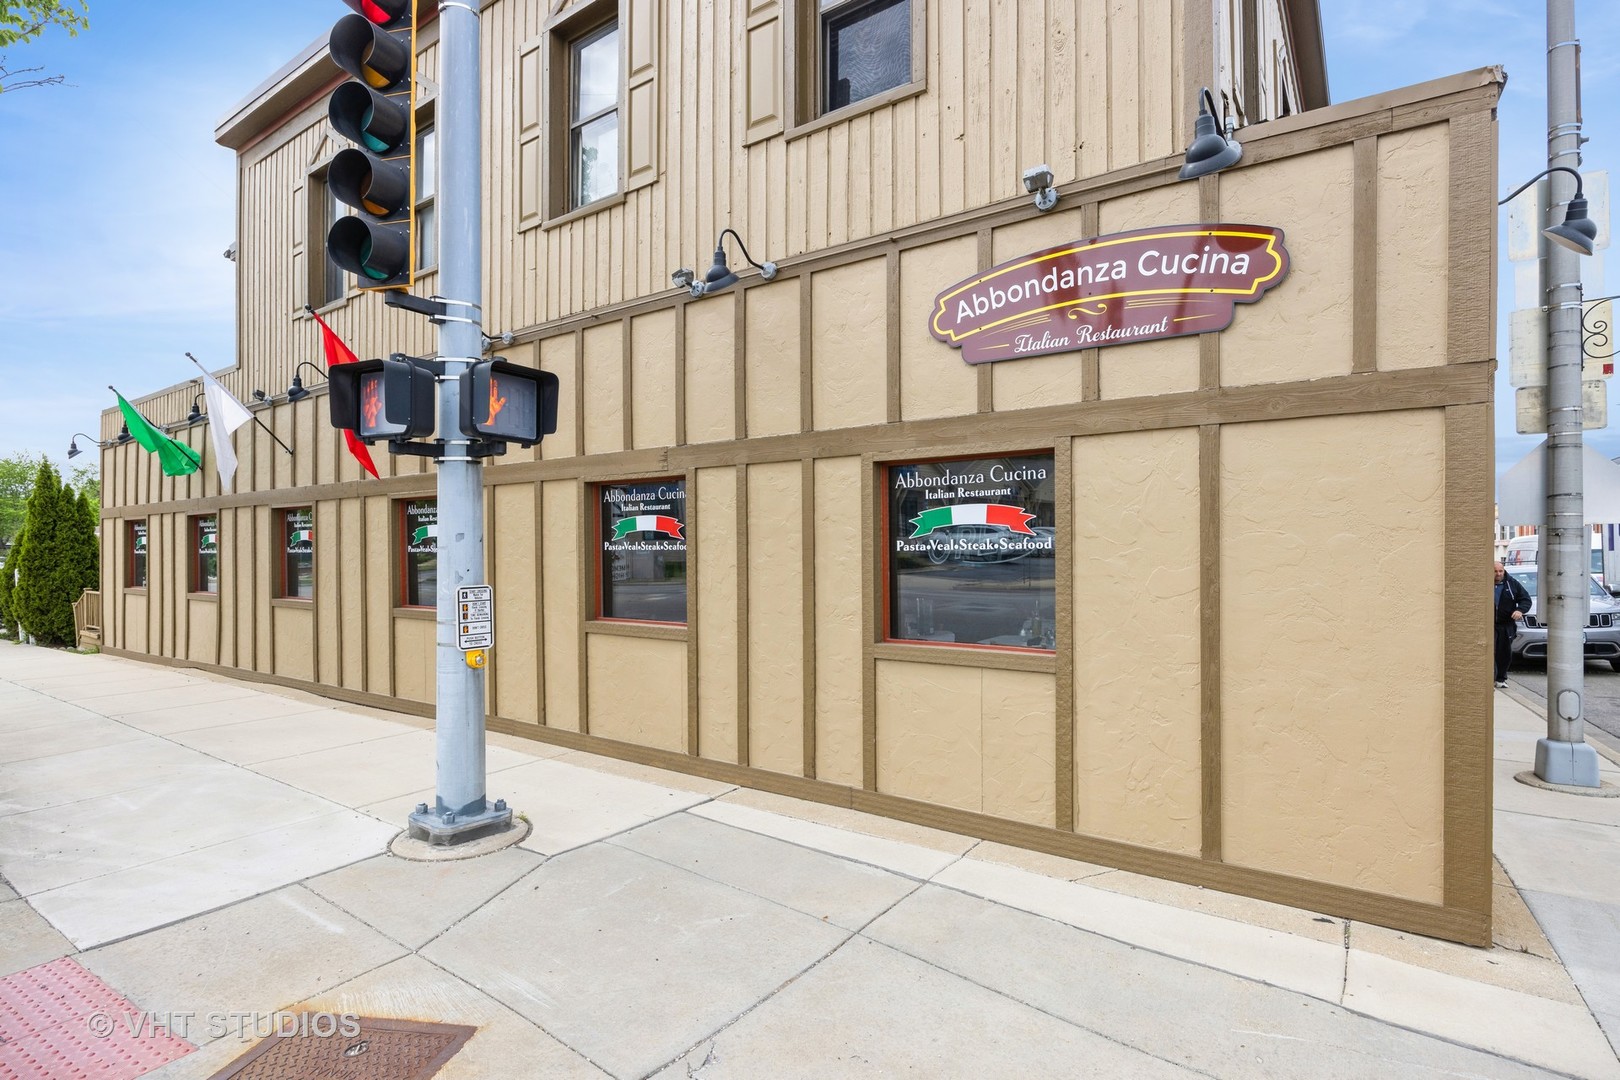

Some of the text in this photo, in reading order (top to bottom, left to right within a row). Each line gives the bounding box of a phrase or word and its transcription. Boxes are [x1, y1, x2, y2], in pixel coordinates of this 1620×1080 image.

[955, 246, 1251, 324] Abbondanza Cucina
[1013, 315, 1169, 353] Italian Restaurant
[895, 464, 1047, 489] Abbondanza Cucina
[603, 486, 687, 503] Abbondanza Cucin
[925, 487, 1011, 500] Italian Restaurant
[406, 504, 438, 514] Abbondanz
[621, 502, 671, 512] Italian Restaurant
